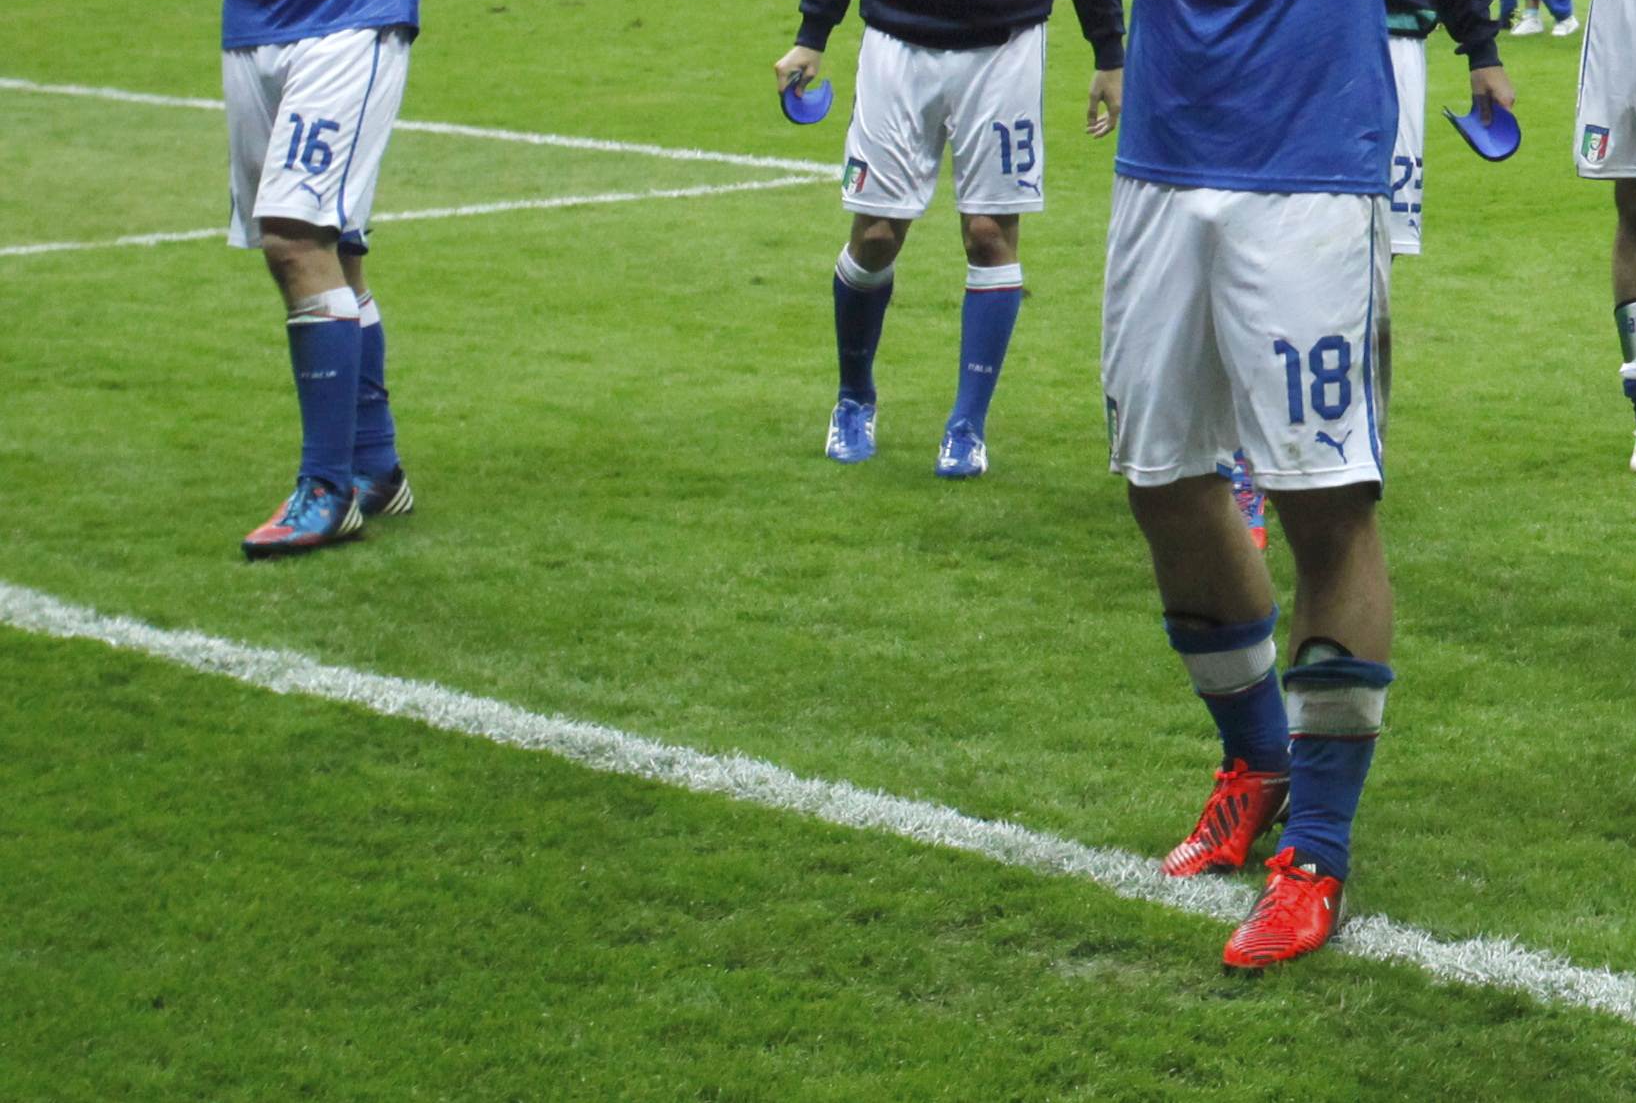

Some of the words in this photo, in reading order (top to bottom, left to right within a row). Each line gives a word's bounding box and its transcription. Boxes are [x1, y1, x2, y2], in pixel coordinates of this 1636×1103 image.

[283, 112, 340, 174] 16
[993, 119, 1035, 175] 13
[1273, 335, 1351, 425] 18
